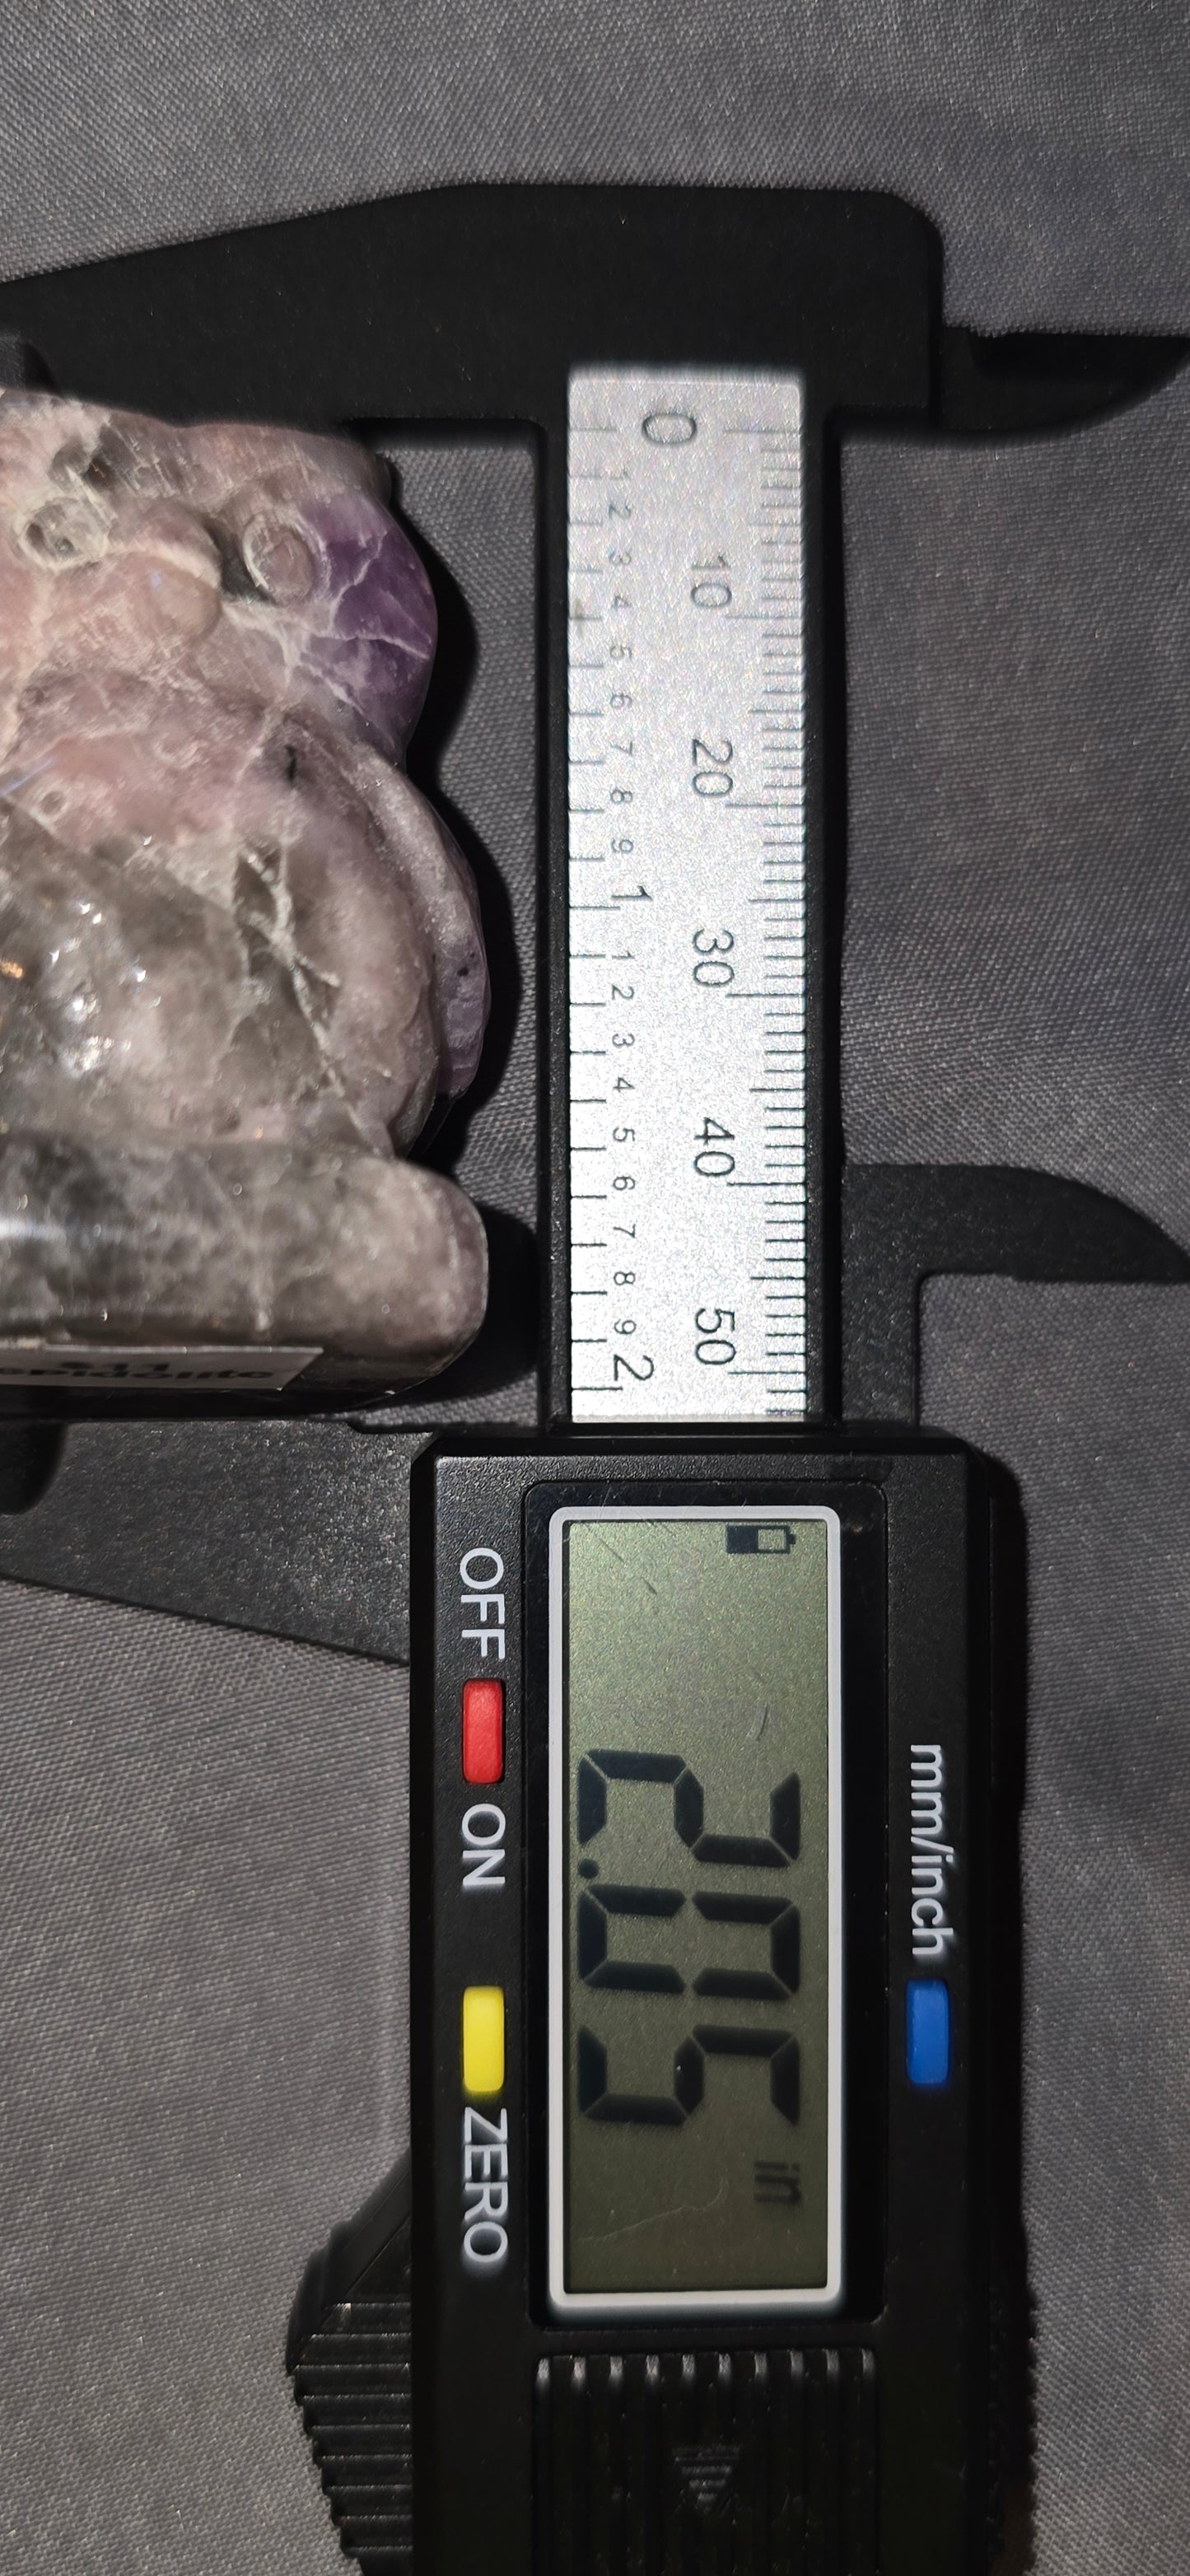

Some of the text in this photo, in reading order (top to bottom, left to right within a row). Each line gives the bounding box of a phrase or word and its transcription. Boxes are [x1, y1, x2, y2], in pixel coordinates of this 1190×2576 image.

[641, 412, 698, 446] 0
[609, 502, 632, 519] 2
[609, 550, 632, 566] 3
[612, 594, 631, 609] 4
[609, 644, 632, 660] 5
[610, 693, 633, 709] 6
[613, 740, 634, 756] 7
[610, 788, 633, 804] 8
[611, 838, 634, 854] 9
[611, 885, 652, 901] 1
[611, 950, 634, 959] 1
[690, 554, 736, 1365] 10 20 30 40 50
[611, 985, 635, 1000] 2
[612, 1033, 636, 1048] 3
[613, 1077, 635, 1093] 4
[612, 1127, 636, 1143] 5
[612, 1176, 636, 1192] 6
[613, 1224, 636, 1239] 7
[613, 1271, 637, 1286] 8
[614, 1319, 637, 1336] 9
[613, 1355, 655, 1381] 2
[459, 1547, 506, 1660] OFF
[460, 1805, 506, 1888] ON
[910, 1744, 954, 1956] mm/inch
[576, 1748, 802, 2207] 2.05 in
[462, 2106, 509, 2266] ZERO
